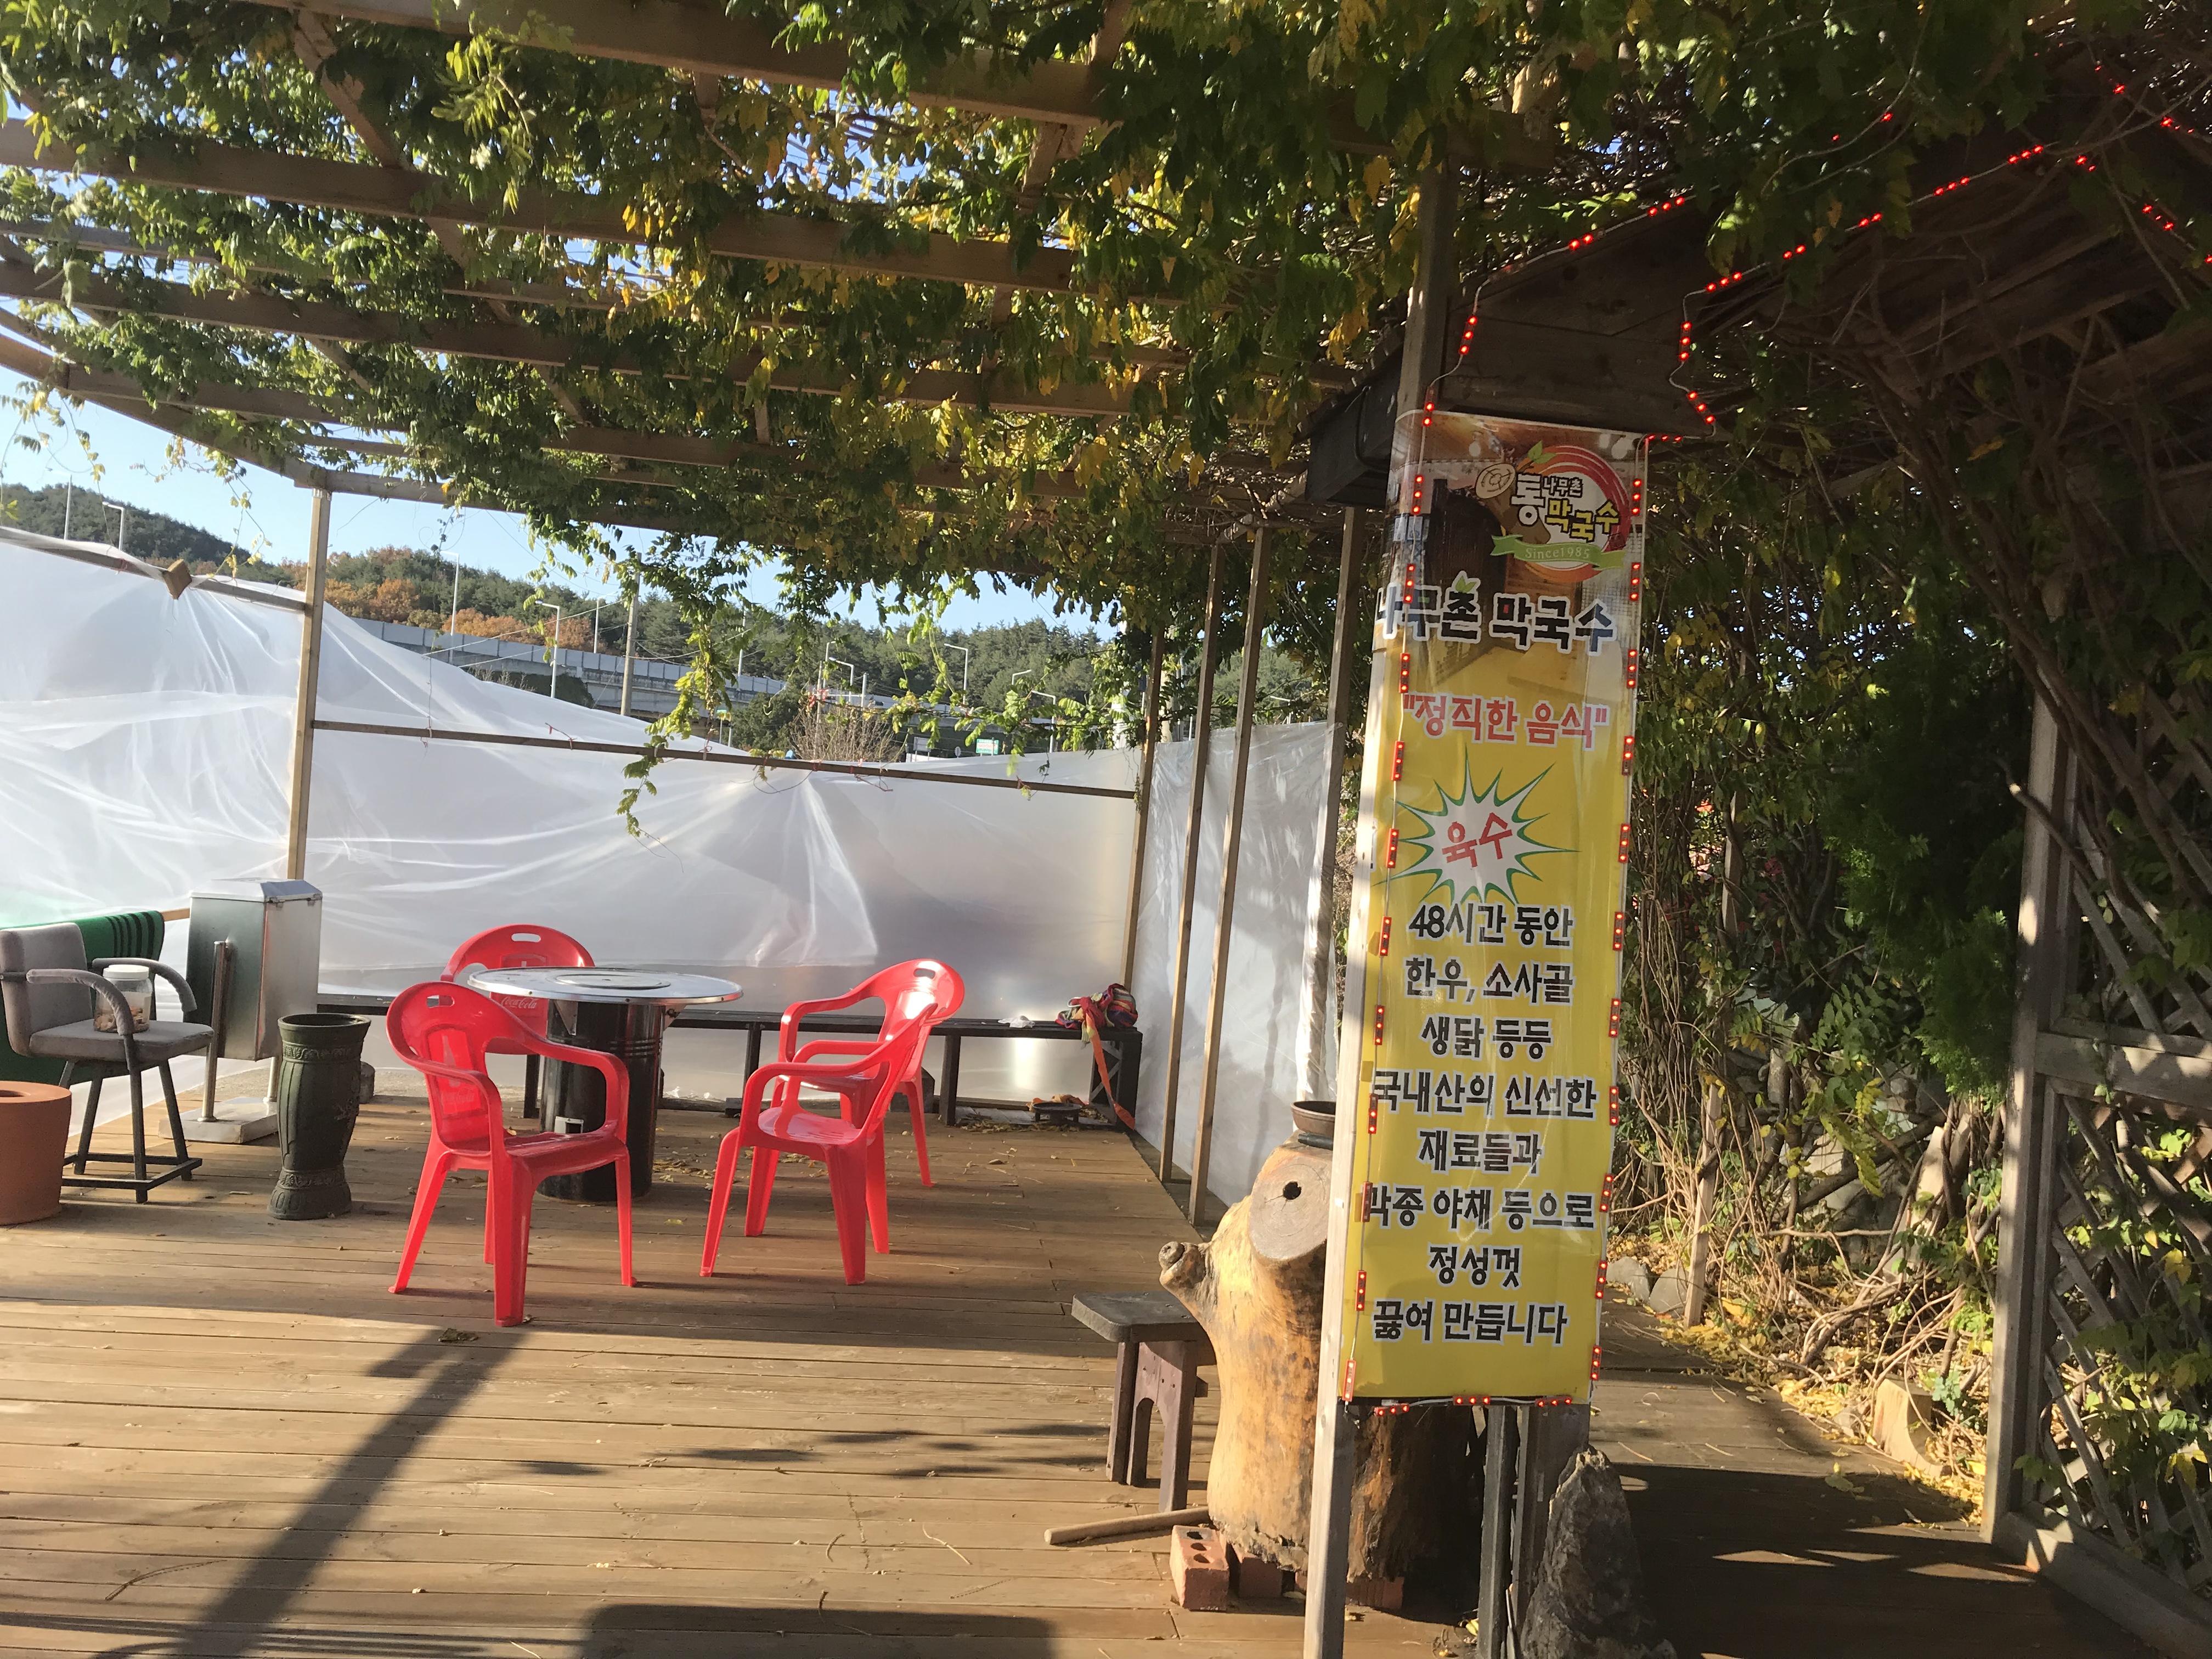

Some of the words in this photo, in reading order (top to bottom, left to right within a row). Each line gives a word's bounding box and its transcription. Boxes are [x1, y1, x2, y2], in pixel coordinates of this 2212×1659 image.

[1544, 498, 1620, 543] 막국수
[1492, 596, 1614, 653] 막국수
[1441, 812, 1513, 868] 육수
[1408, 902, 1507, 944] 48시간
[1514, 907, 1573, 947] 동안
[1406, 957, 1475, 1002] 한우,
[1483, 963, 1573, 1003] 소사골
[1421, 1016, 1485, 1058] 생닭
[1492, 1019, 1551, 1059] 등등
[1374, 1071, 1494, 1116] 국내산의
[1505, 1077, 1596, 1118] 신선한
[1419, 1130, 1542, 1174] 재료들과
[1433, 1188, 1492, 1230] 야채
[1502, 1191, 1594, 1230] 등으로
[1429, 1246, 1520, 1288] 정성껏
[1373, 1301, 1433, 1341] 끓여
[1444, 1302, 1568, 1344] 만듭니다
